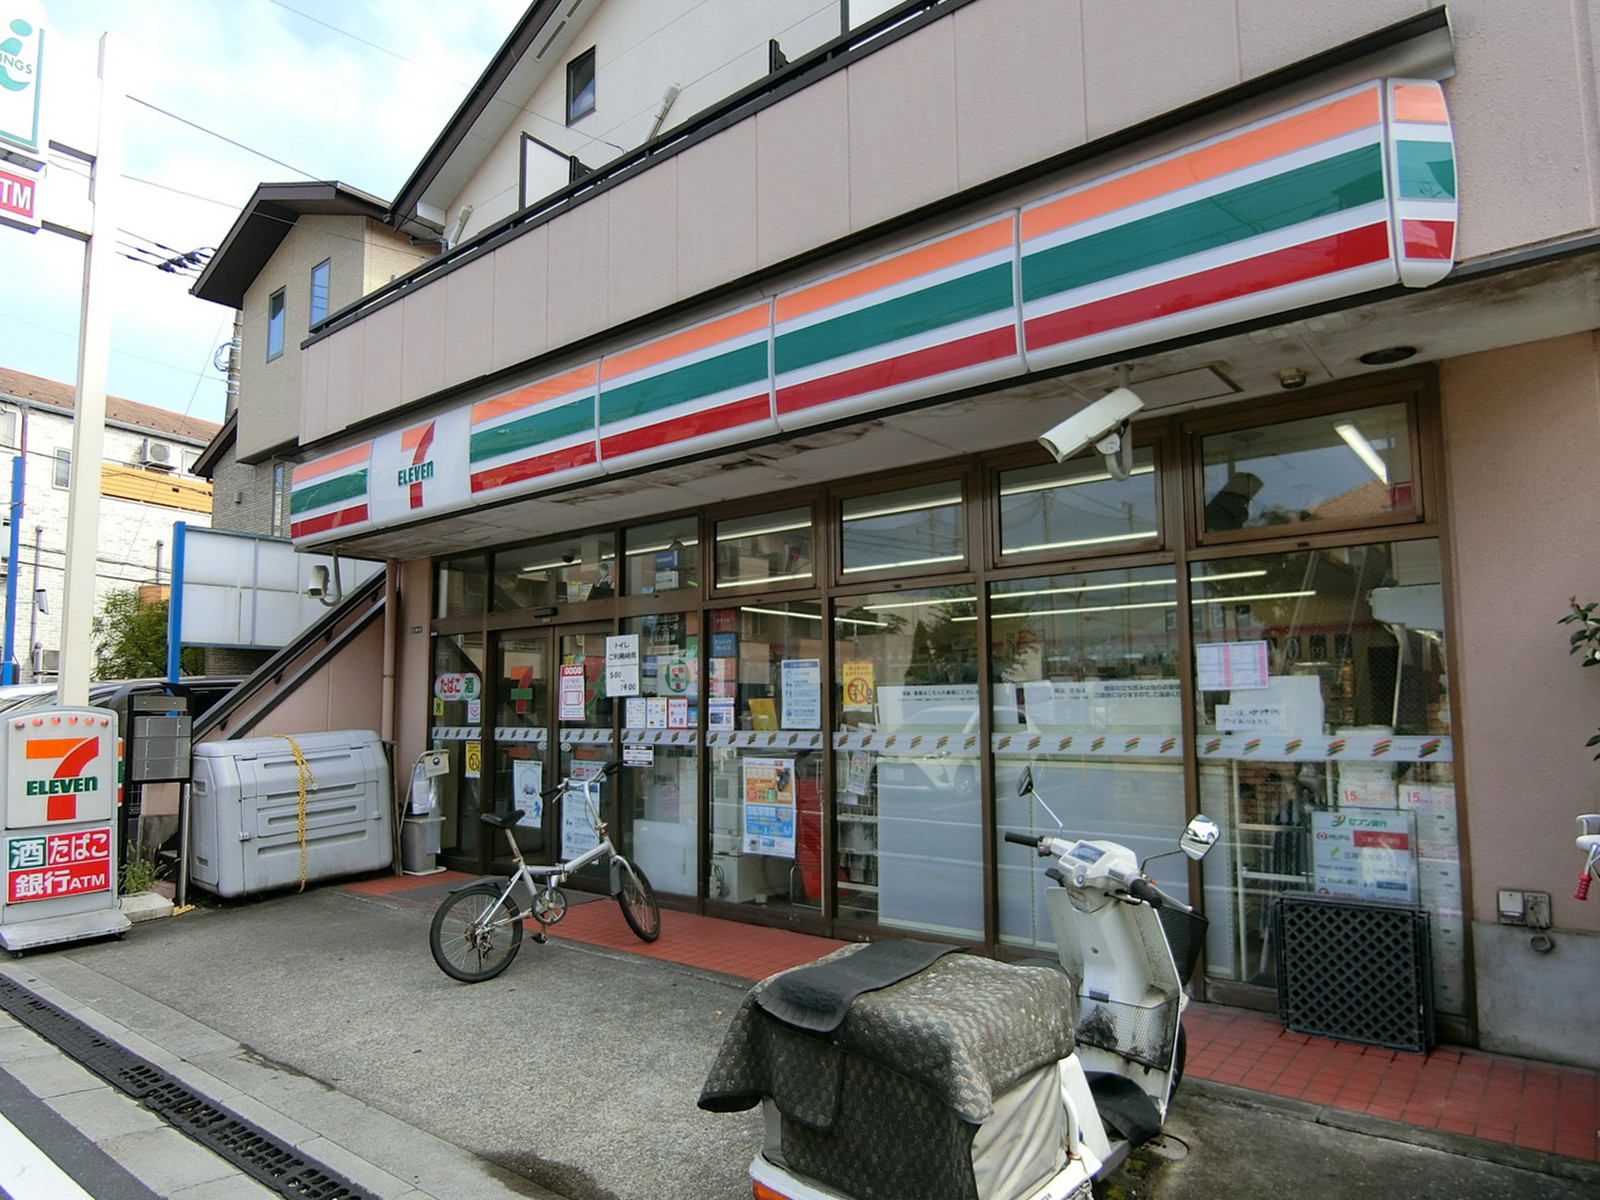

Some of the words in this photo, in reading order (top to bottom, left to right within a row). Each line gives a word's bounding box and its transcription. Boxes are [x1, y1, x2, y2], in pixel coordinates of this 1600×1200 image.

[401, 421, 436, 509] 7
[614, 641, 630, 649] トイレ
[440, 677, 461, 694] たばこ
[464, 677, 475, 694] 酒
[26, 736, 99, 821] 7
[1349, 818, 1388, 828] セブン銀行
[11, 839, 45, 869] 酒
[49, 832, 108, 864] たばこ
